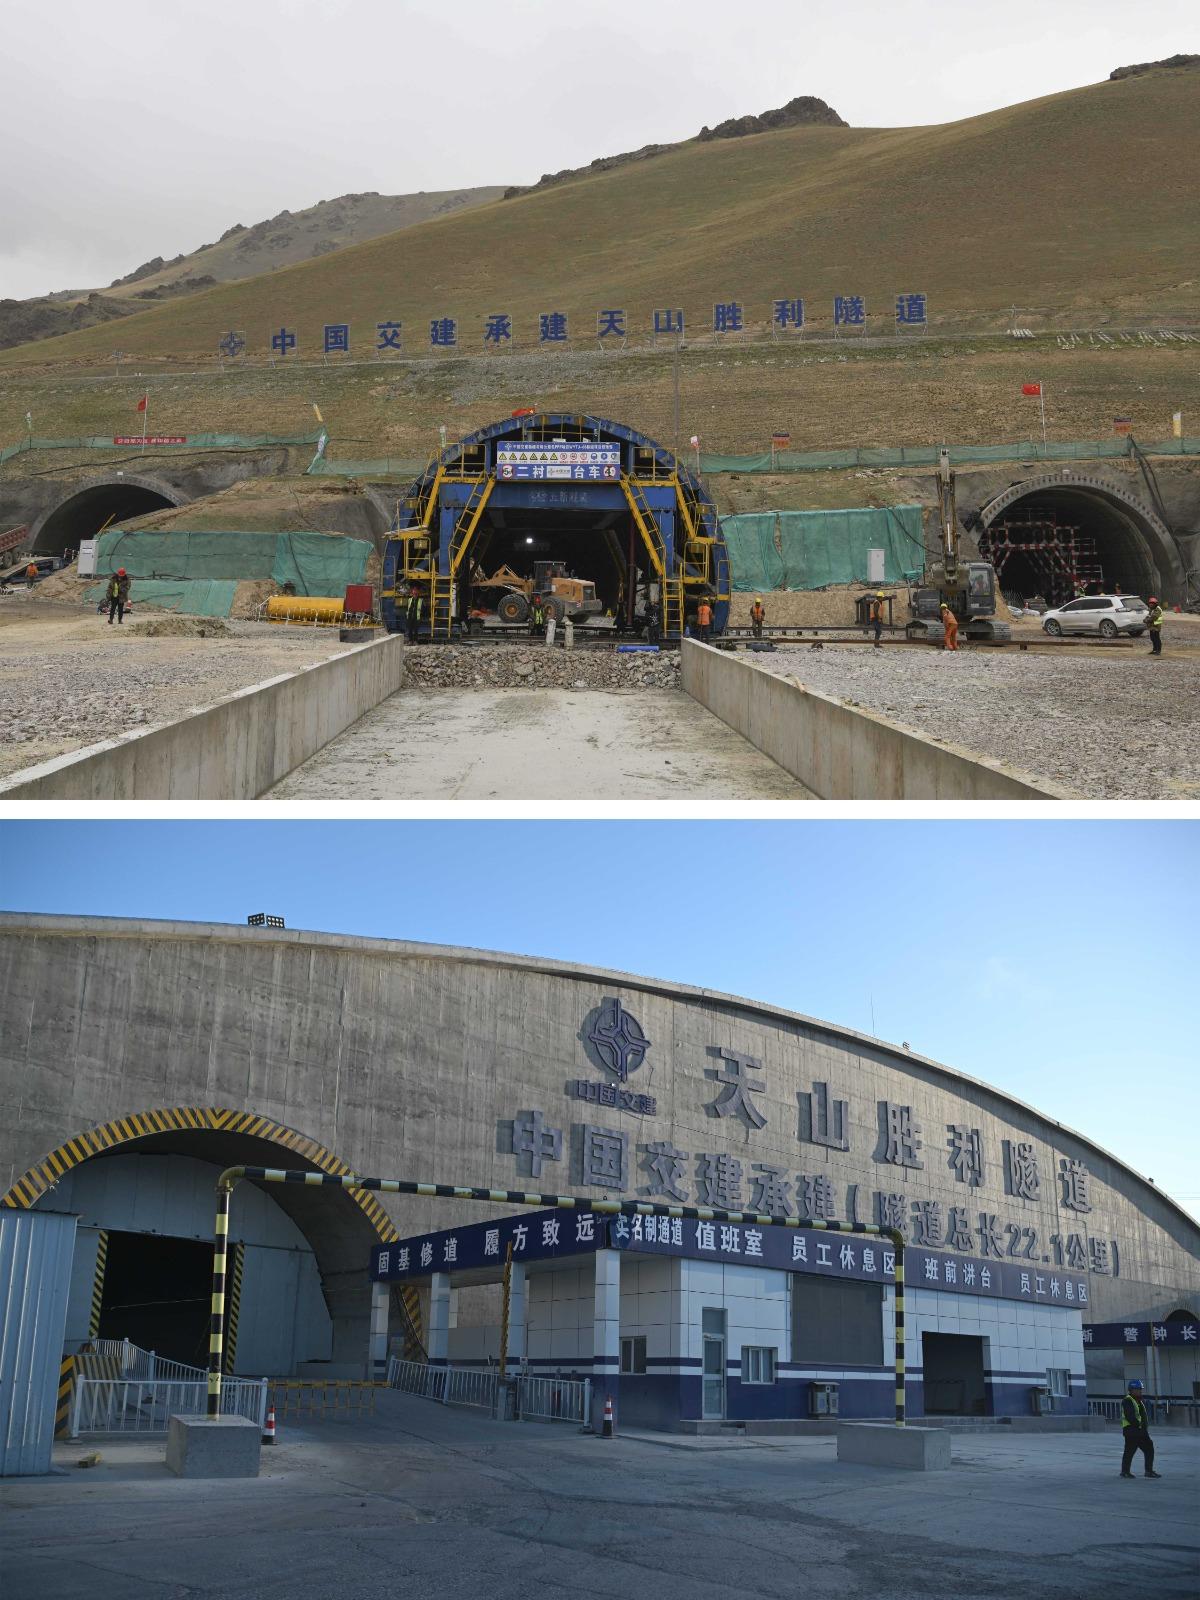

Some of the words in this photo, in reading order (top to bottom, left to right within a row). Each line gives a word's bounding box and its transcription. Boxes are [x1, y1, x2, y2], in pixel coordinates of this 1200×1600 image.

[271, 294, 928, 355] 中国交建承建天山胜利隧道
[574, 465, 601, 479] 台车
[577, 1080, 657, 1116] 中国交建
[711, 1046, 1093, 1213] 天山胜利隧道
[378, 1237, 458, 1275] 固基修道
[484, 1213, 595, 1257] 履方致远
[615, 1212, 683, 1246] 实名制通道
[695, 1221, 764, 1257] 值班室
[791, 1236, 897, 1275] 员工休息区
[924, 1257, 992, 1289] 班前讲台
[1020, 1272, 1088, 1303] 员工休息区
